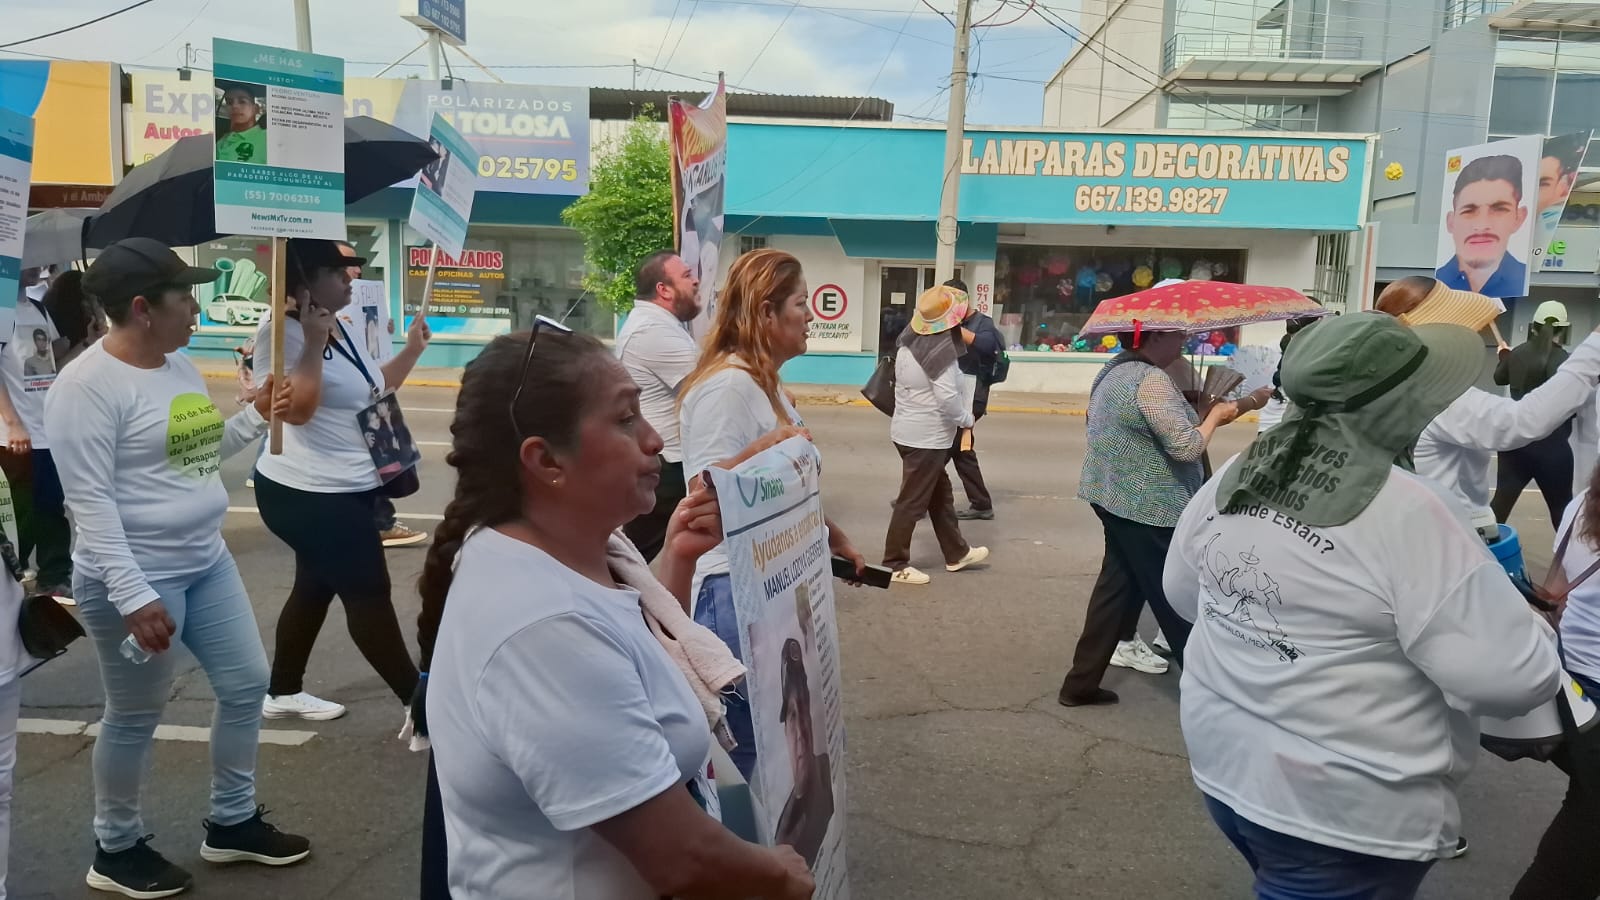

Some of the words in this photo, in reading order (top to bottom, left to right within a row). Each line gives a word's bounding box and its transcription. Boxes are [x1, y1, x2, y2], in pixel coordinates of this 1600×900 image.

[279, 56, 303, 68] HAS
[427, 95, 573, 112] POLARIZADOS
[458, 111, 572, 139] TOLOSA
[961, 140, 1125, 177] LAMPARAS
[1132, 143, 1350, 182] DECORATIVAS
[227, 172, 270, 181] PARADERO
[244, 189, 266, 202] (55)
[269, 191, 321, 205] 70062316
[1074, 184, 1229, 214] 667.139.9827
[977, 284, 989, 293] 66
[823, 293, 836, 311] E
[812, 322, 836, 330] ENTRADA
[838, 323, 850, 331] POR
[173, 413, 187, 423] 30
[187, 410, 199, 418] de
[171, 432, 190, 444] Día
[169, 447, 183, 457] de
[185, 442, 198, 452] las
[752, 529, 794, 573] Ayúdanos
[763, 567, 792, 602] MANUEL
